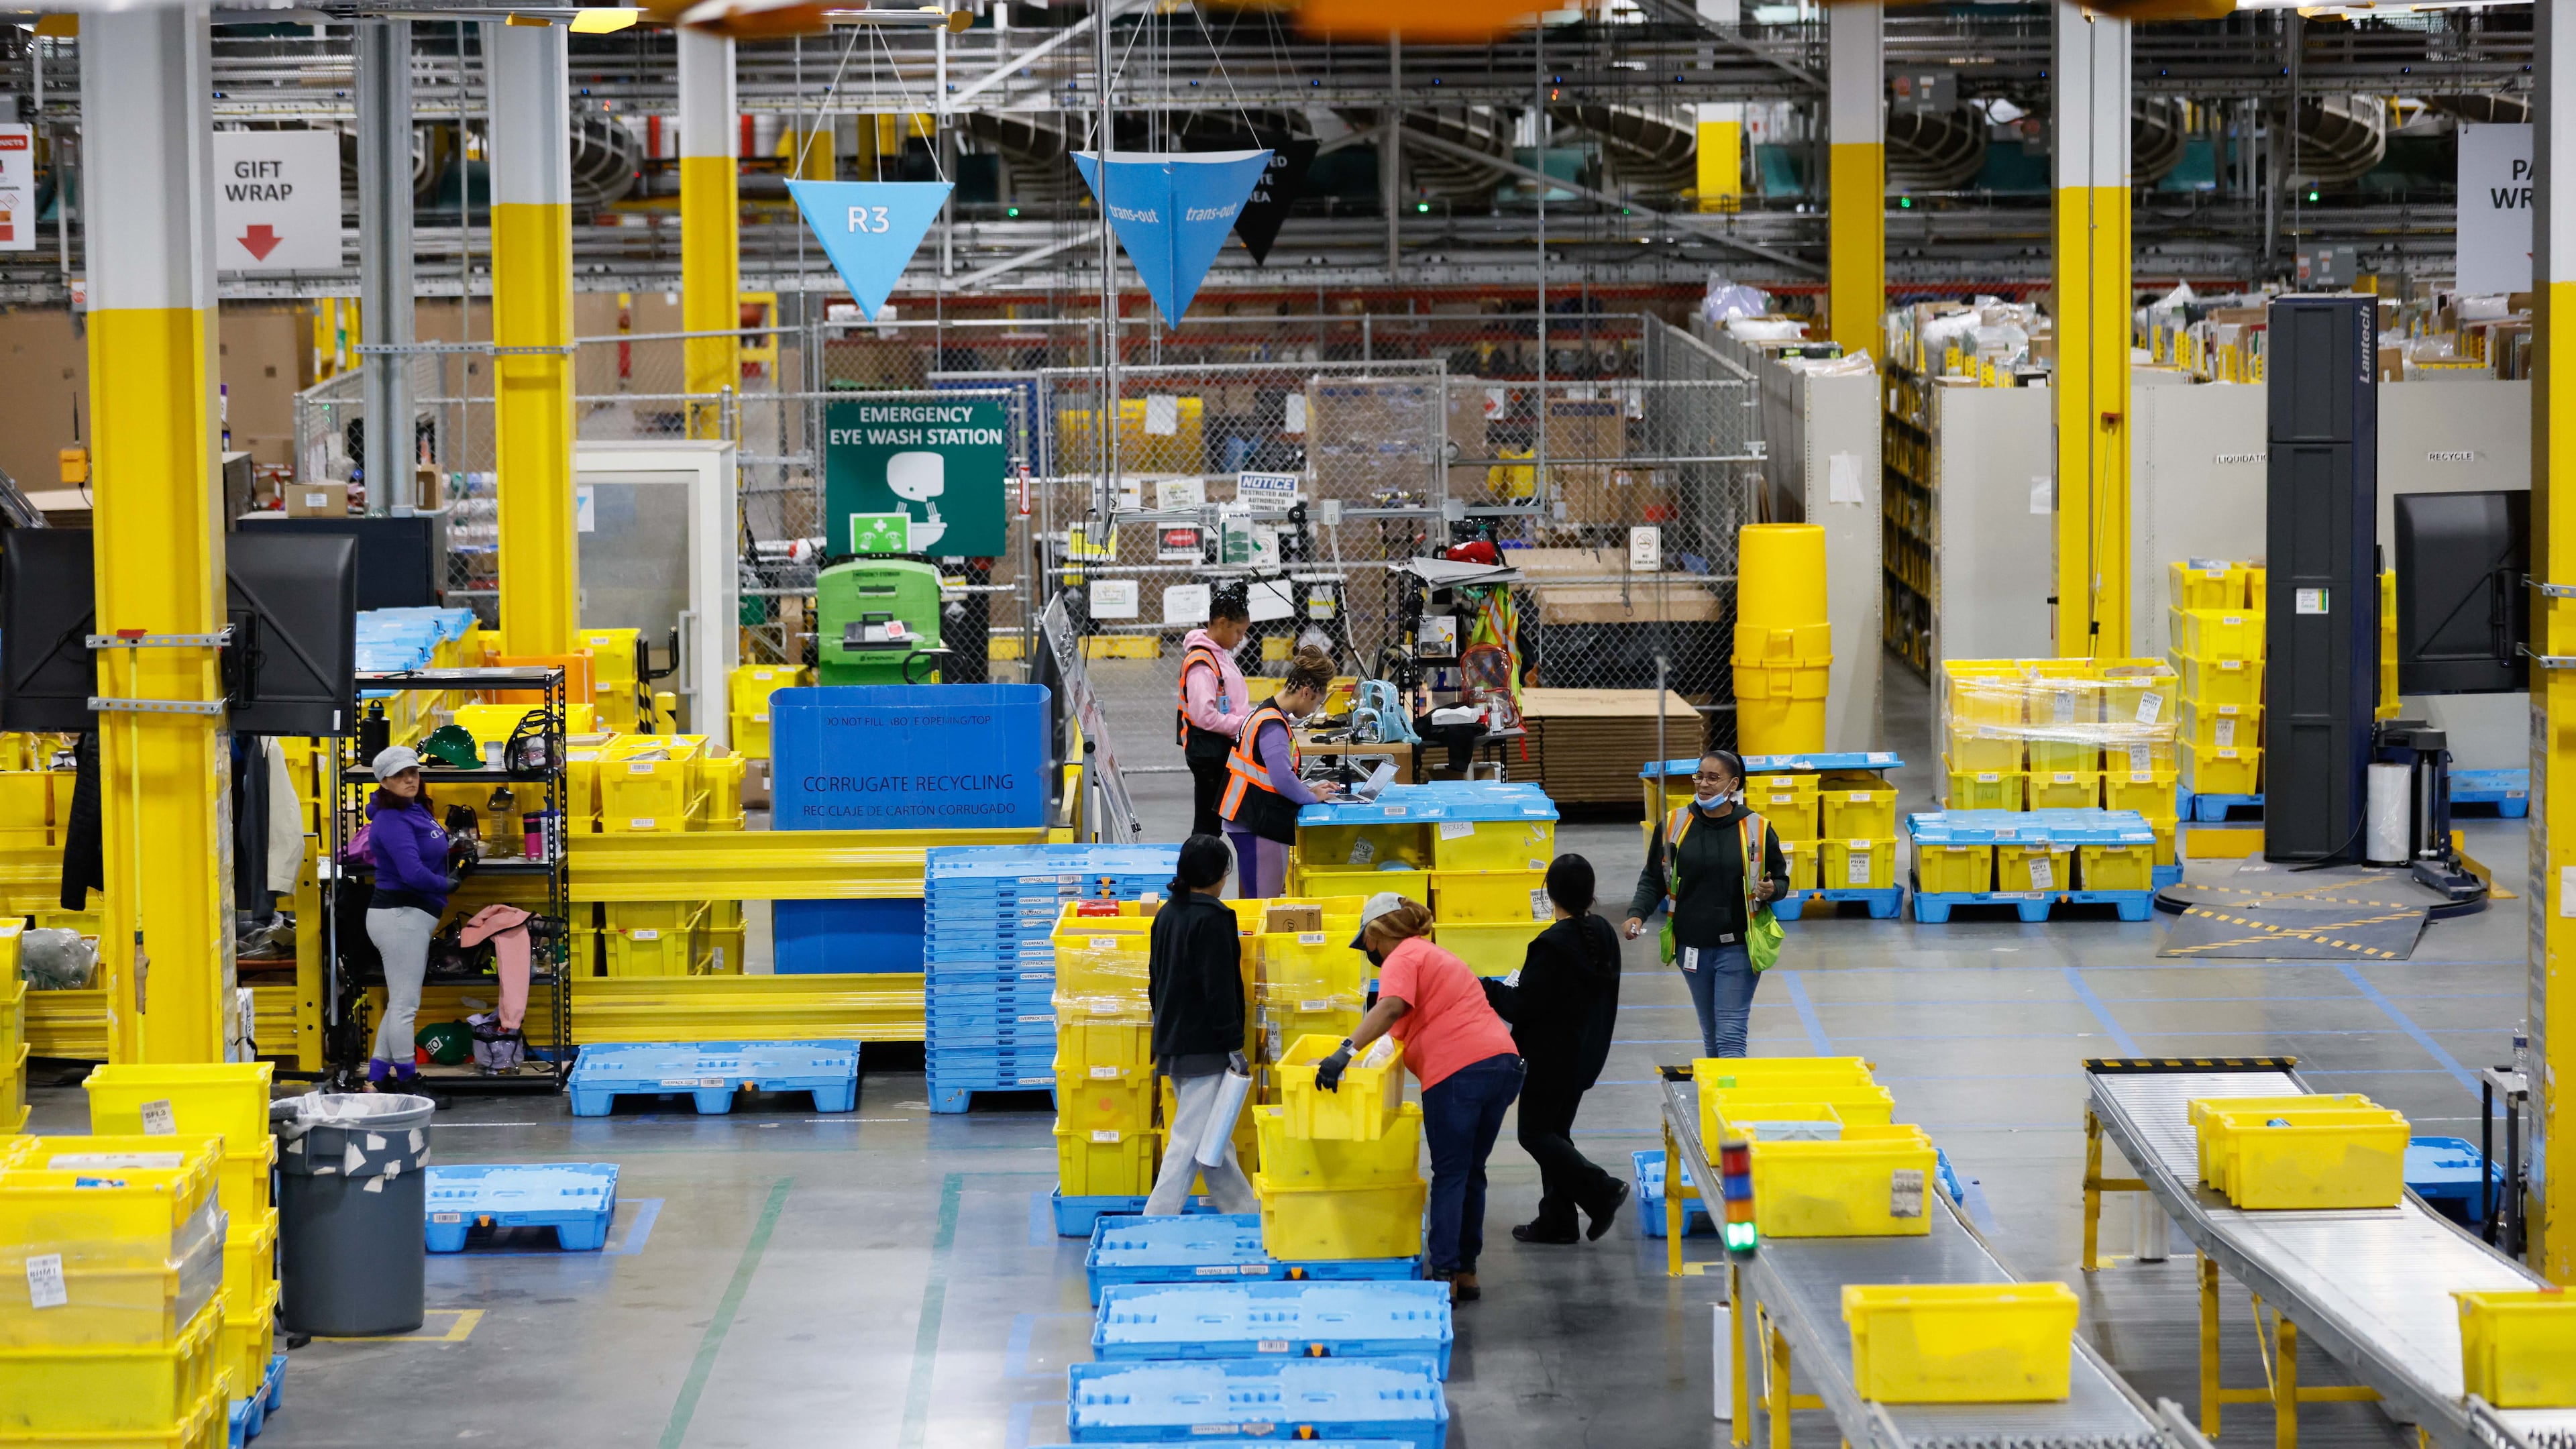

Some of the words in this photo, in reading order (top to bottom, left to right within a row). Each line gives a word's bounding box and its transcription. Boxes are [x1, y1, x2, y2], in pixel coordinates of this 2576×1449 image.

[235, 160, 282, 178] GIFT
[225, 184, 292, 201] WRAP
[848, 206, 890, 233] R3
[1109, 203, 1160, 223] trans-out
[1185, 202, 1238, 221] trans-out
[2359, 305, 2370, 384] Lantech
[860, 407, 973, 423] EMERGENCY
[830, 429, 862, 445] EYE
[867, 429, 922, 445] WASH
[926, 429, 1002, 445] STATION
[2429, 452, 2473, 461] RECYCLE
[1242, 476, 1293, 490] NOTICE
[842, 717, 861, 726] NOT
[865, 717, 883, 726] FILL
[804, 776, 908, 792] CORRUGATE
[916, 774, 1014, 791] RECYCLING
[804, 805, 863, 816] RECCLAJE
[867, 805, 882, 816] DE
[939, 803, 1016, 815] CORRUGADO
